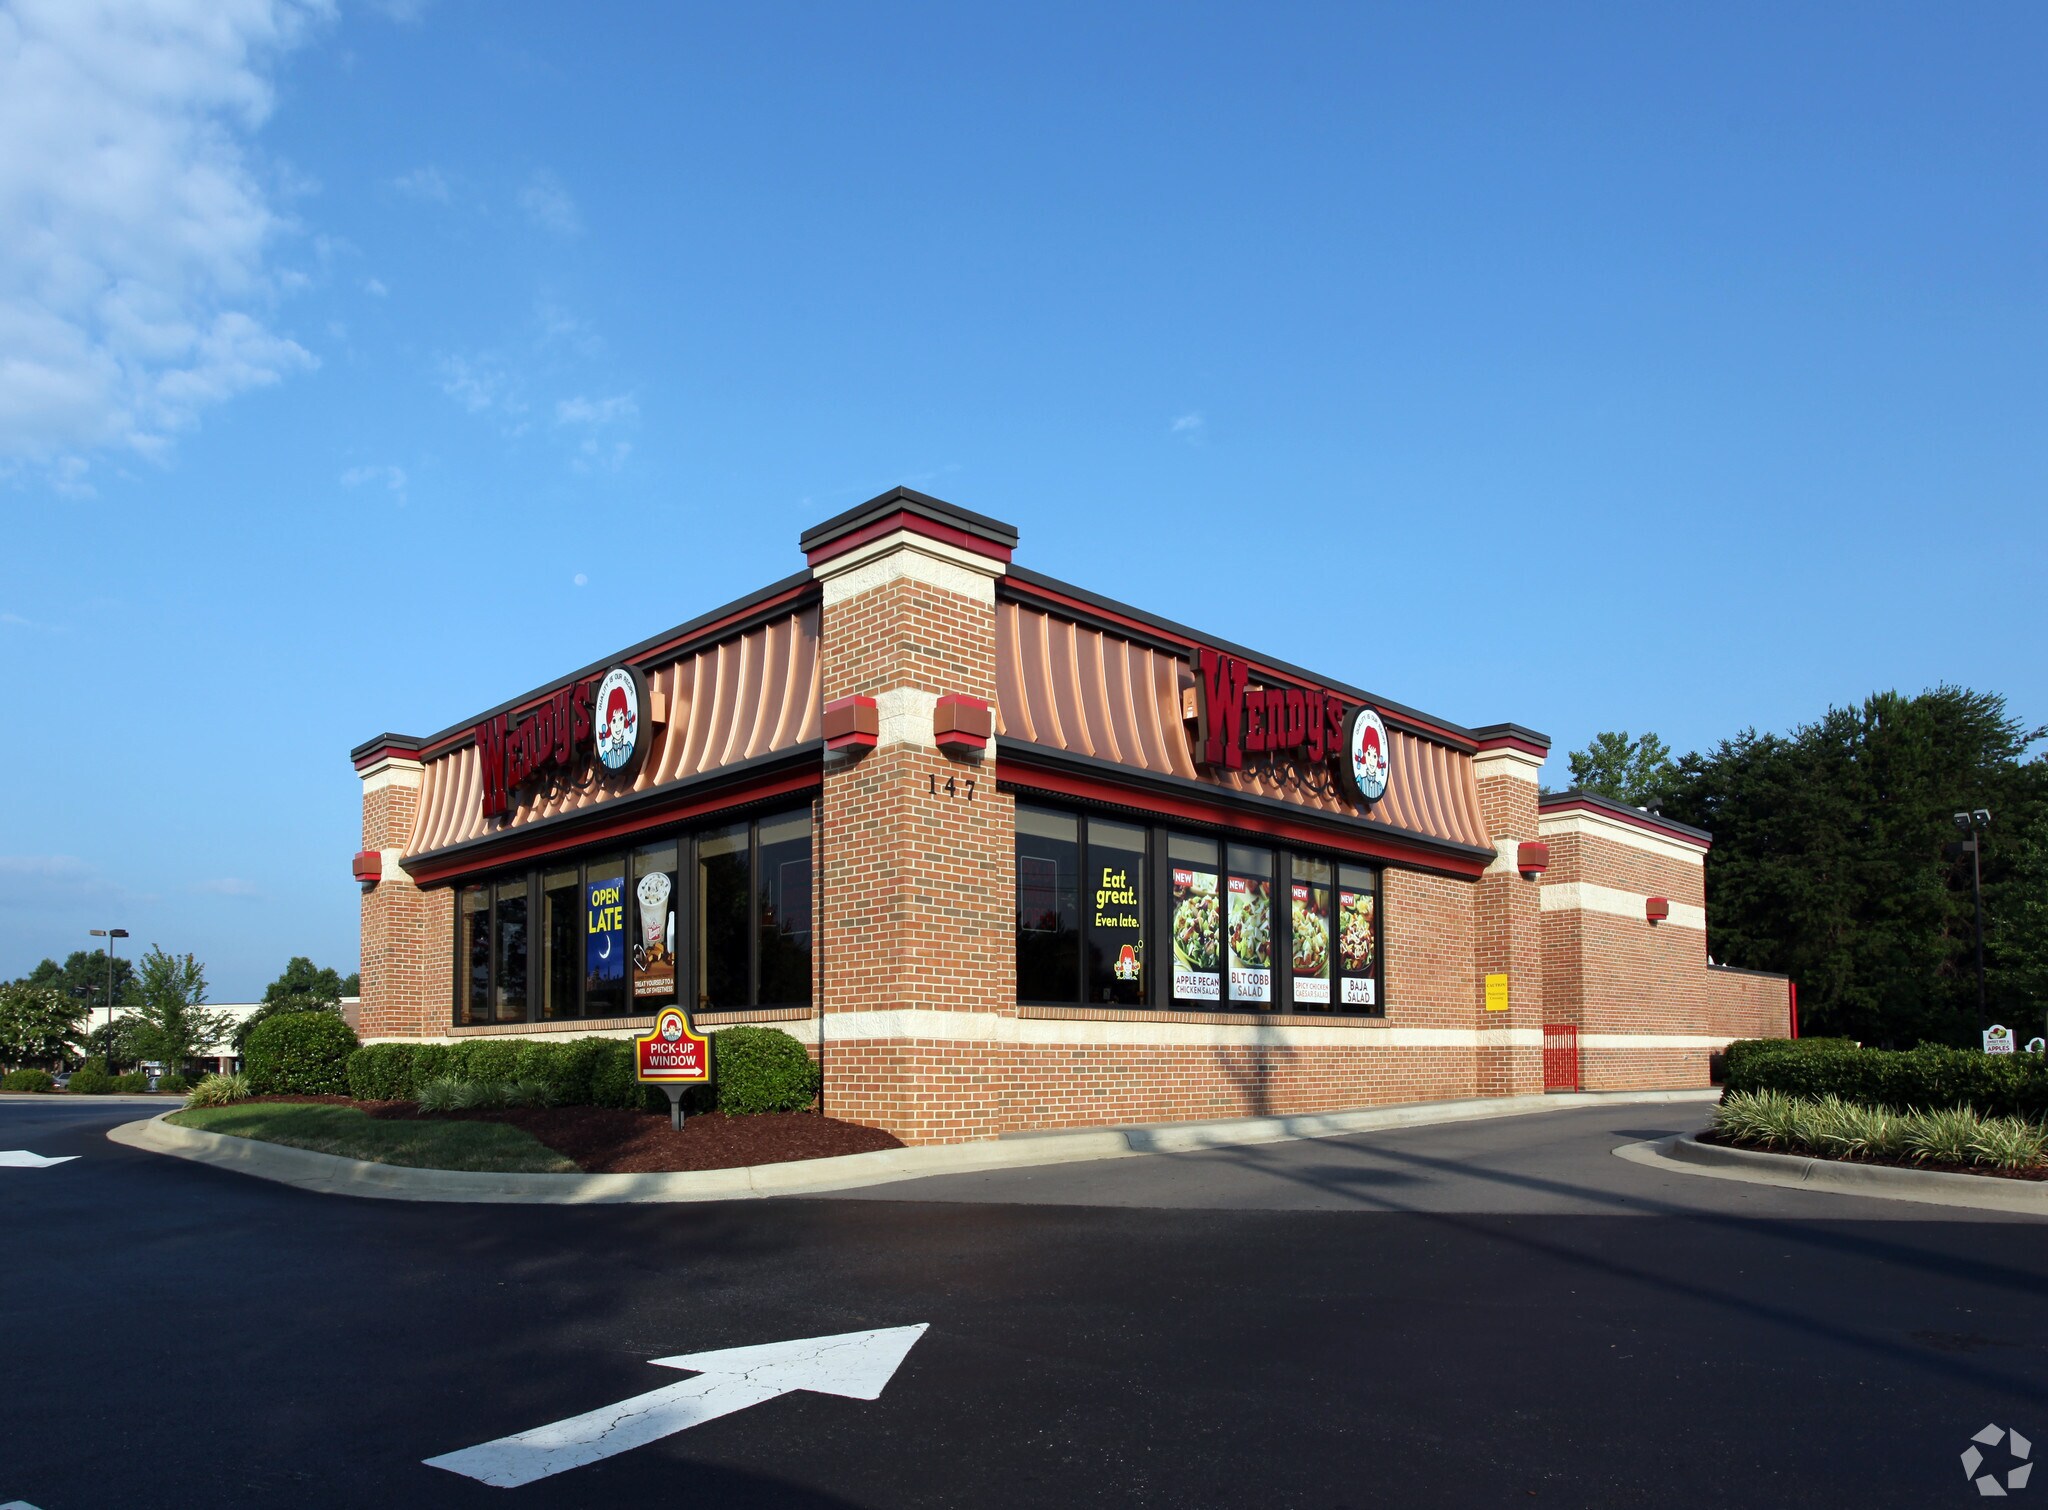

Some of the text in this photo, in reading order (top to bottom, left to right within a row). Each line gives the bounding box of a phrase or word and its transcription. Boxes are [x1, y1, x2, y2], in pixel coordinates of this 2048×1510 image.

[1200, 649, 1344, 769] WENDY'S
[929, 774, 976, 801] 147
[1102, 867, 1126, 889] Eat
[1175, 870, 1192, 884] NEW
[1229, 879, 1245, 892] NEW
[592, 886, 619, 907] OPEN
[1096, 886, 1138, 909] great.
[1293, 887, 1308, 899] NEW
[1340, 894, 1354, 904] NEW
[589, 906, 622, 934] LATE
[1095, 912, 1140, 928] Even late.
[1176, 975, 1219, 987] APPLE PECAN
[1231, 972, 1269, 986] BLT COBB
[1175, 985, 1219, 995] CHICKEN SALAD
[1237, 985, 1263, 997] SALAD
[1295, 981, 1329, 990] SPICY CHICKEN
[1349, 980, 1368, 991] BAJA
[1295, 989, 1329, 998] CAESAR SALAD
[1347, 991, 1370, 1003] SALAD
[650, 1043, 695, 1054] PICK-UP
[649, 1055, 696, 1066] WINDOW
